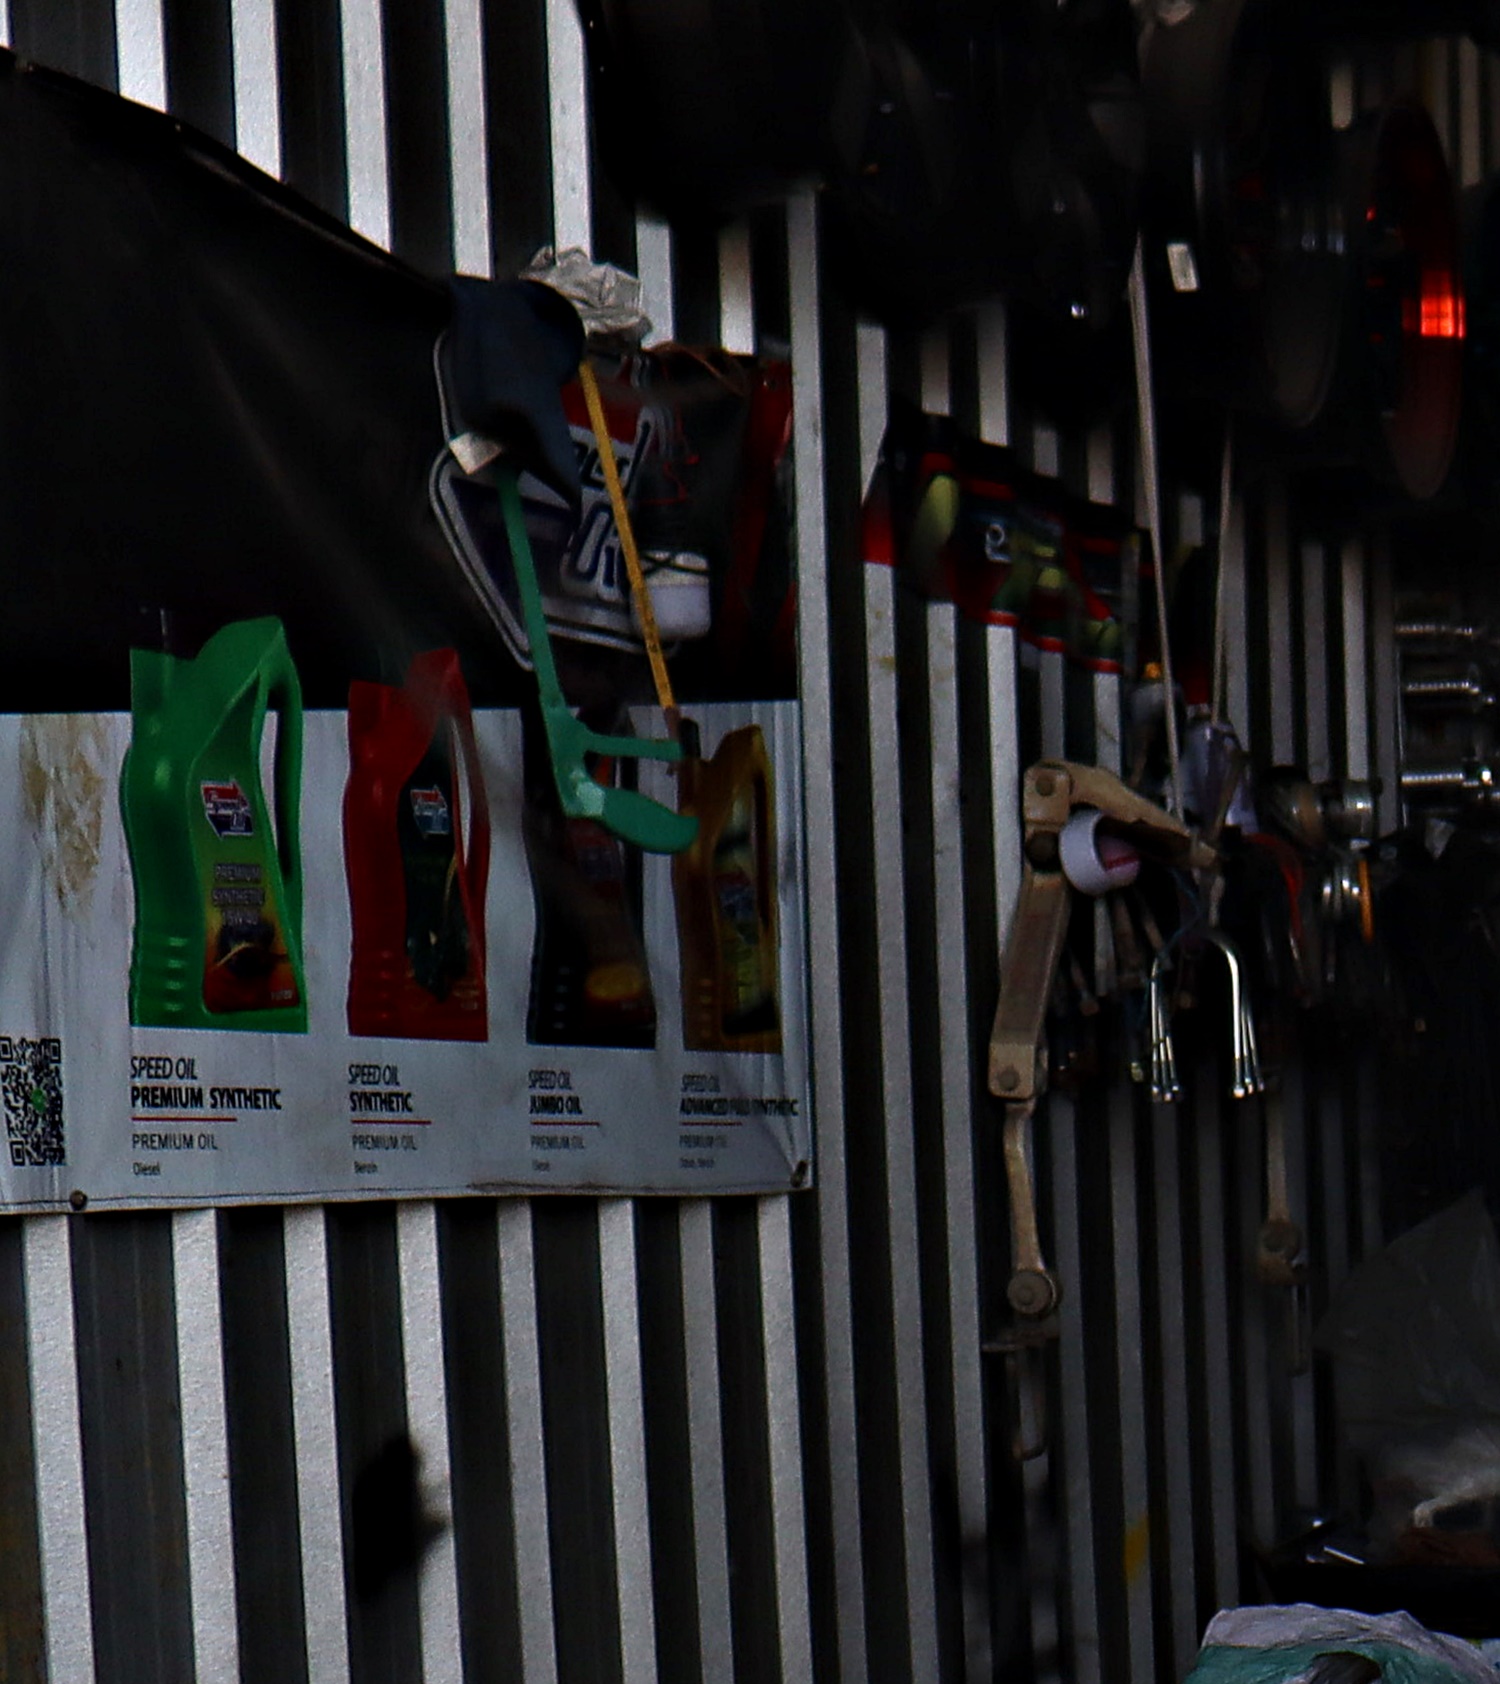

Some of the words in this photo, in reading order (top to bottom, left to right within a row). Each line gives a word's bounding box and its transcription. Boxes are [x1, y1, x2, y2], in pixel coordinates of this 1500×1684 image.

[130, 1056, 173, 1079] SPEED
[176, 1058, 197, 1080] OIL
[348, 1065, 381, 1086] SPEED
[382, 1065, 400, 1086] OIL
[528, 1070, 556, 1089] SPEED
[558, 1071, 572, 1090] OIL
[682, 1074, 705, 1092] SPEED
[131, 1087, 203, 1109] PREMIUM
[210, 1089, 281, 1110] SYNTHETIC
[350, 1092, 413, 1112] SYNTHETIC
[529, 1095, 563, 1114] JUMBO
[565, 1096, 583, 1115] OIL
[132, 1133, 194, 1150] PREMIUM
[197, 1134, 218, 1150] OIL
[352, 1135, 398, 1150] PREMIUM
[400, 1136, 418, 1150] OIL
